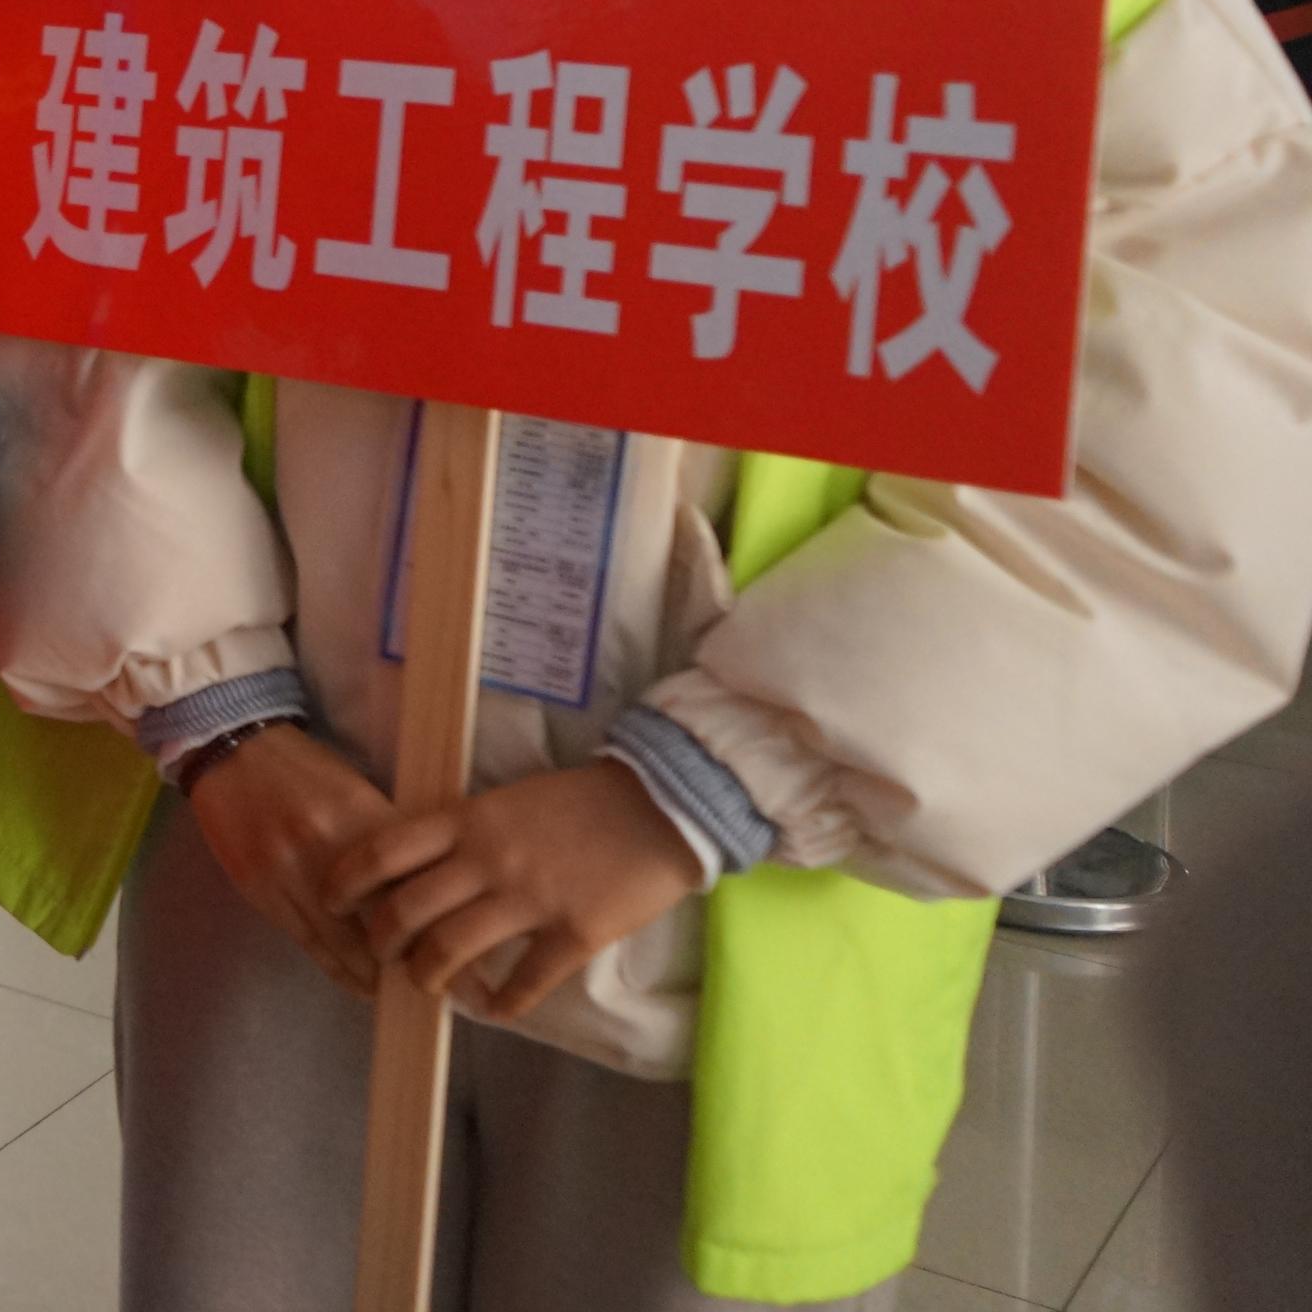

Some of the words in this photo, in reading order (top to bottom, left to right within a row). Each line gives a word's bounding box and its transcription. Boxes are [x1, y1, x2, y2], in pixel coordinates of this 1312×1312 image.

[23, 11, 1016, 394] 建筑工程学校
